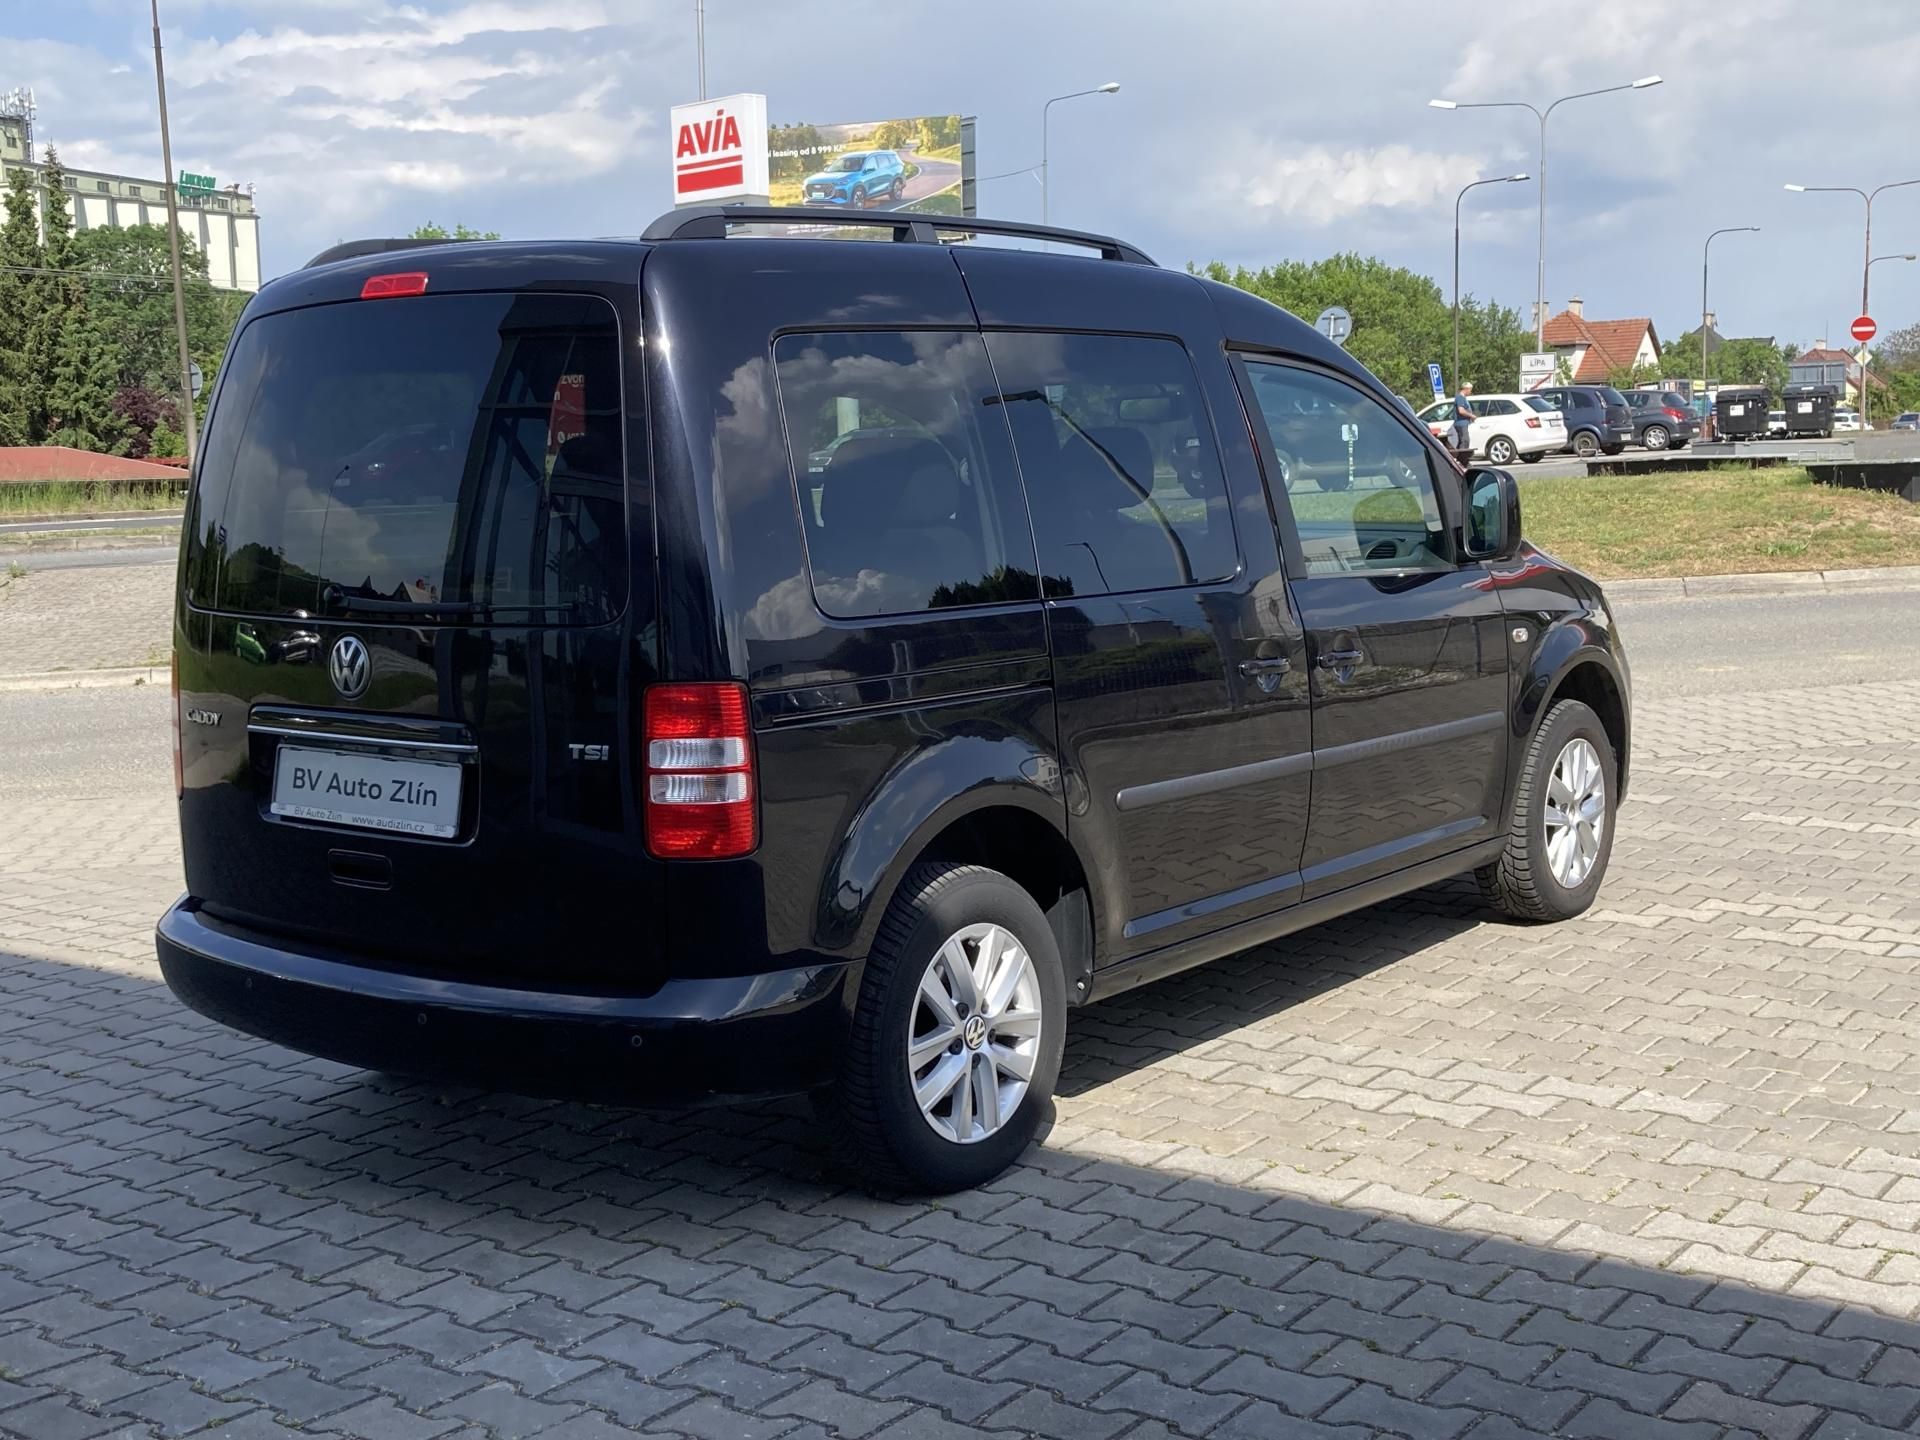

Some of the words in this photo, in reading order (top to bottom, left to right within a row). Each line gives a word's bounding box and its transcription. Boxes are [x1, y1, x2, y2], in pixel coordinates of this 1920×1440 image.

[773, 149, 799, 158] leasing
[800, 147, 810, 155] od
[811, 146, 817, 155] 8
[818, 145, 832, 154] 999
[568, 743, 609, 761] TSI
[292, 767, 322, 791] BV
[326, 772, 382, 800] Auto
[389, 779, 438, 807] Zlín
[294, 807, 304, 815] BV
[305, 809, 326, 820] Auto
